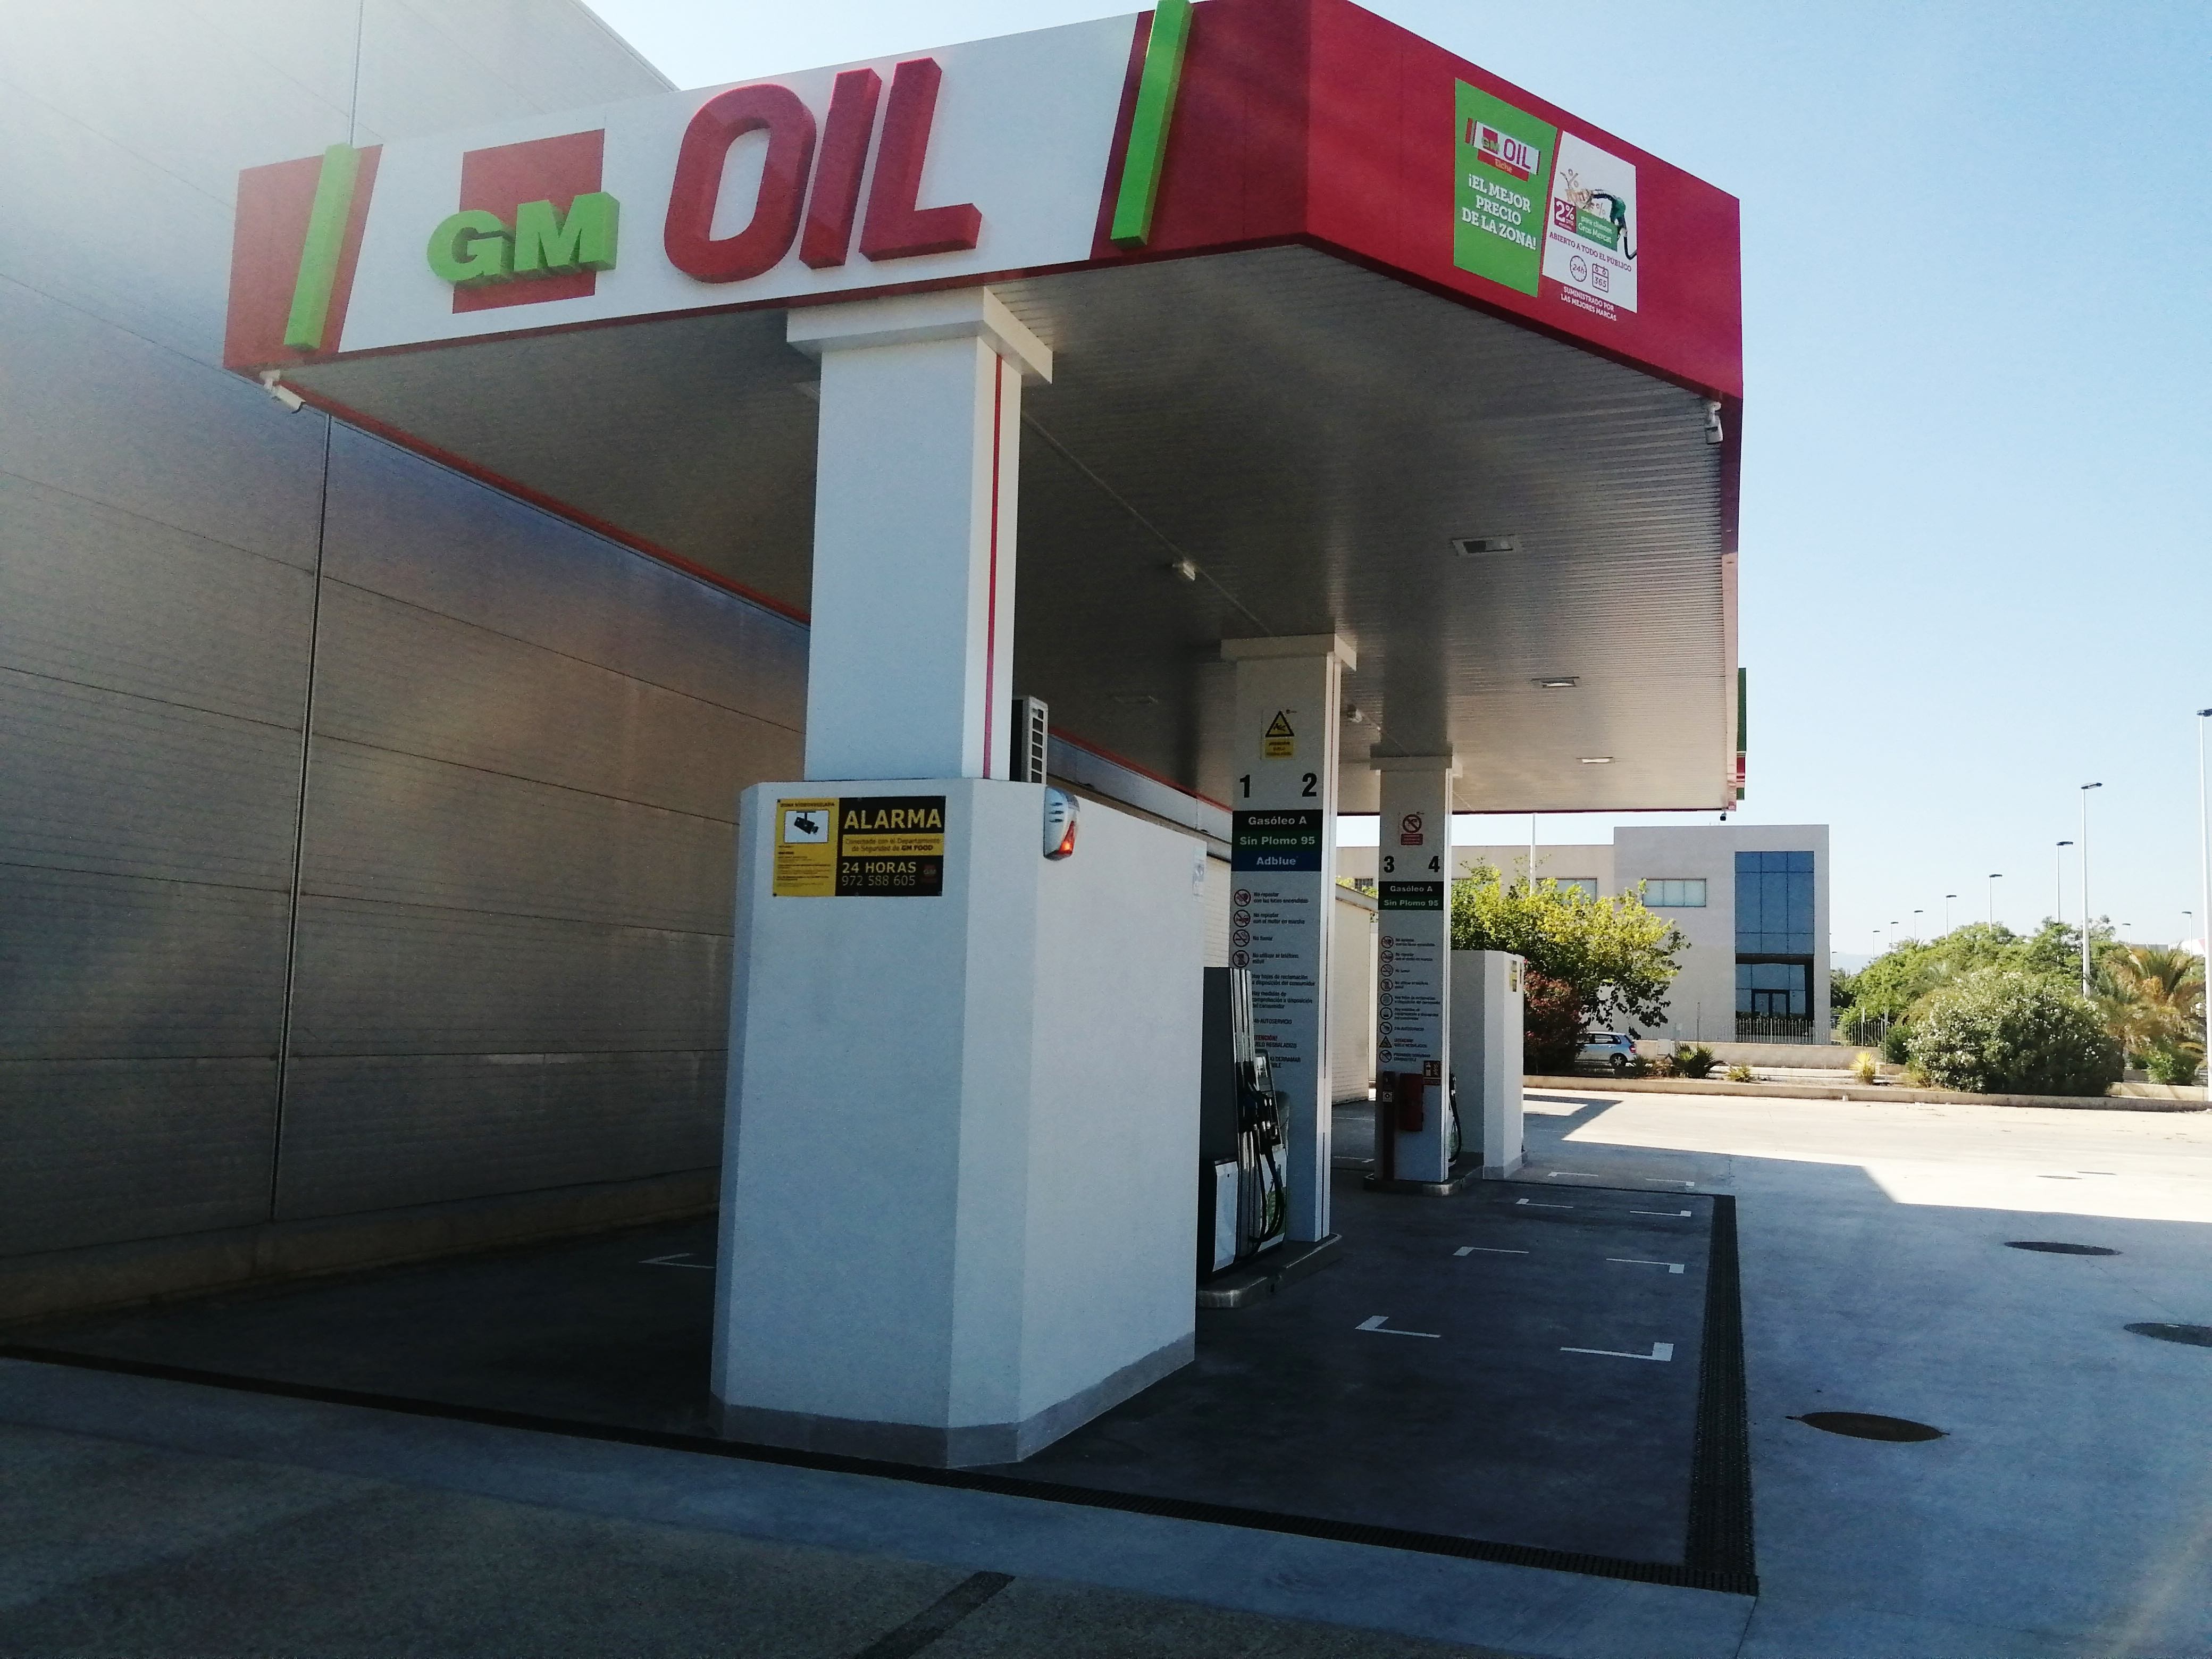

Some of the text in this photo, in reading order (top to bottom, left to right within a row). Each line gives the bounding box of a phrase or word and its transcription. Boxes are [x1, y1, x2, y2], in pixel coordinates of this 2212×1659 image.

[1504, 139, 1531, 169] OIL
[427, 57, 982, 287] GM OIL
[1495, 158, 1512, 173] Elche
[1469, 173, 1531, 213] ¡EL MEJOR
[1476, 195, 1521, 225] PRECIO
[1462, 207, 1479, 227] DE
[1481, 215, 1497, 234] LA
[1499, 222, 1536, 250] ZONA!
[1581, 216, 1612, 234] para clientes
[1593, 229, 1612, 244] Mercat
[1549, 232, 1576, 248] ABIERTO
[1581, 245, 1598, 258] TODO
[1599, 253, 1606, 261] EL
[1572, 264, 1585, 274] 24h
[1594, 276, 1606, 288] 365
[1561, 294, 1616, 321] LAS MEJORES MARCAS
[1563, 286, 1614, 312] SUMINISTRADO POR
[1239, 773, 1317, 798] 1 2
[844, 808, 942, 829] ALARMA
[1249, 816, 1295, 825] Gasóleo
[1240, 836, 1315, 845] Sin Plomo 95
[842, 861, 916, 874] 24 HORAS
[1256, 856, 1296, 866] Adblue
[1384, 856, 1440, 873] 3 4
[842, 875, 915, 886] 972 588 605
